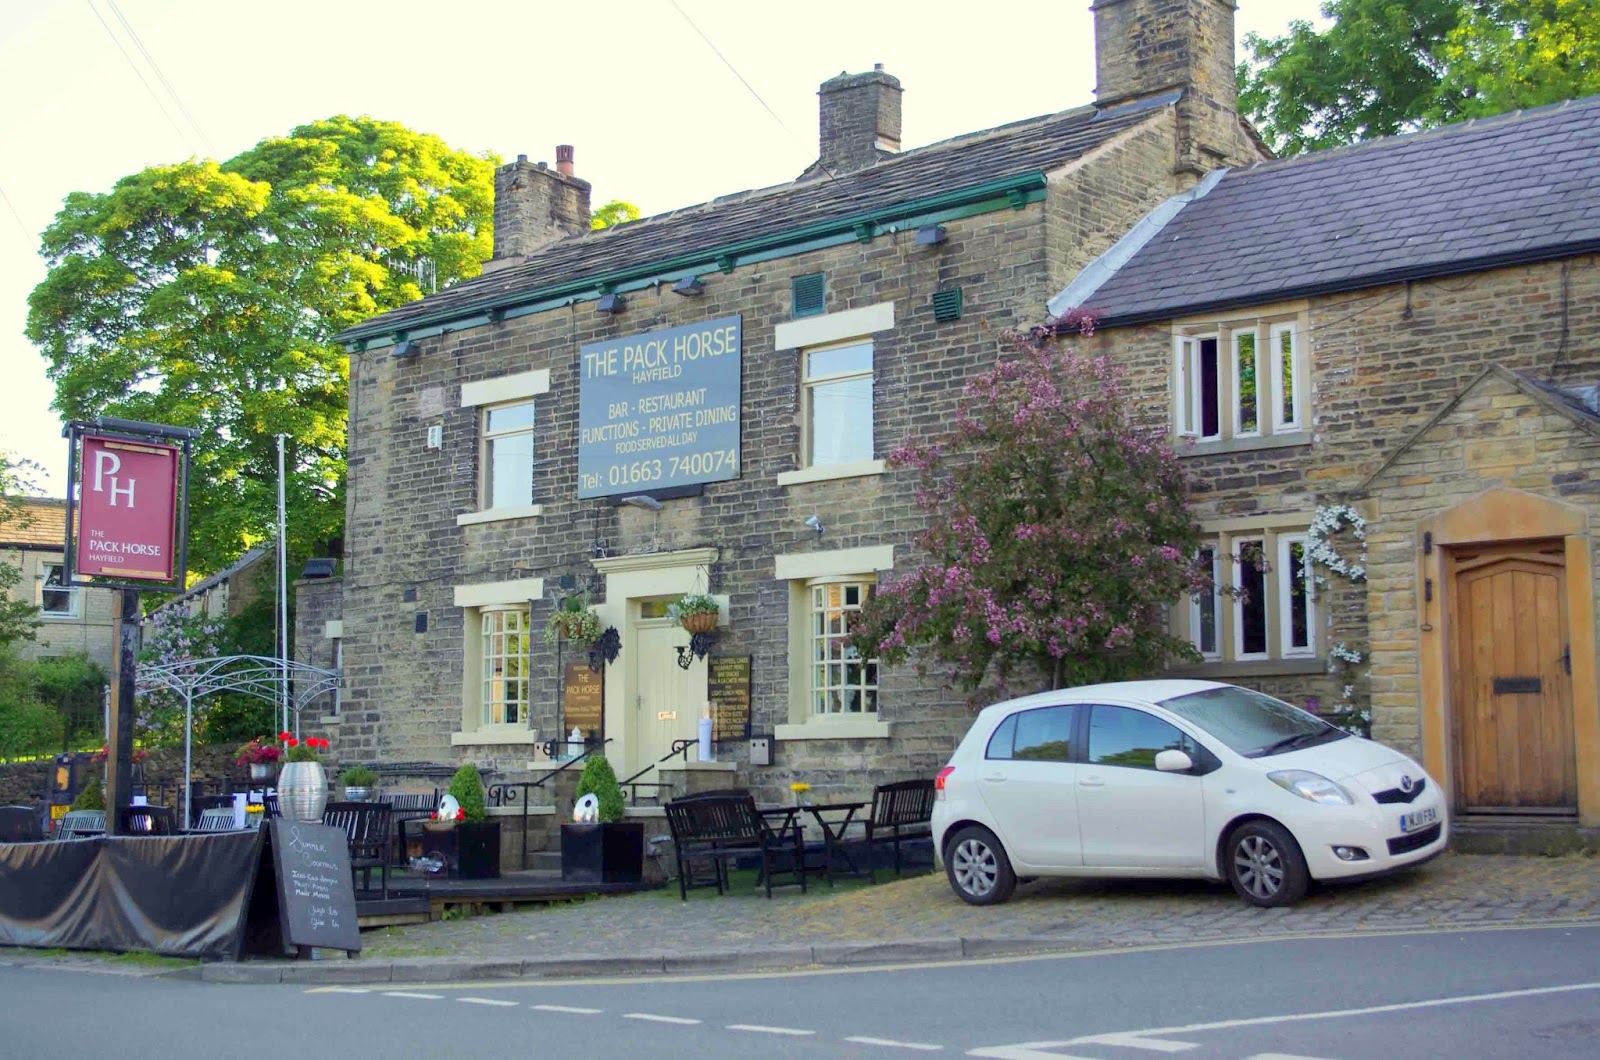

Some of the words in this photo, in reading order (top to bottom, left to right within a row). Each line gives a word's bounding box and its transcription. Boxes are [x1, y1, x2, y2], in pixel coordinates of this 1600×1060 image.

[585, 349, 617, 378] THE
[624, 340, 668, 372] PACK
[674, 326, 736, 362] HORSE
[632, 364, 682, 384] HAYFIELD
[609, 402, 629, 419] BAR
[639, 388, 707, 415] RESTAURANT
[582, 421, 639, 445] FUNCTIONS
[649, 412, 692, 434] PRIVATE
[696, 405, 736, 427] DINING
[616, 441, 636, 454] FOOD
[636, 437, 666, 451] SERVED
[666, 434, 682, 446] ALL
[682, 431, 698, 444] DAY
[581, 473, 602, 490] Tel:
[609, 459, 662, 486] 01663
[669, 449, 737, 478] 740074
[91, 529, 104, 538] THE
[90, 539, 119, 552] PACK
[122, 542, 160, 556] HORSE
[89, 554, 124, 563] HAYFIELD
[578, 673, 589, 683] THE
[566, 685, 580, 694] PACK
[581, 684, 600, 694] HORSE
